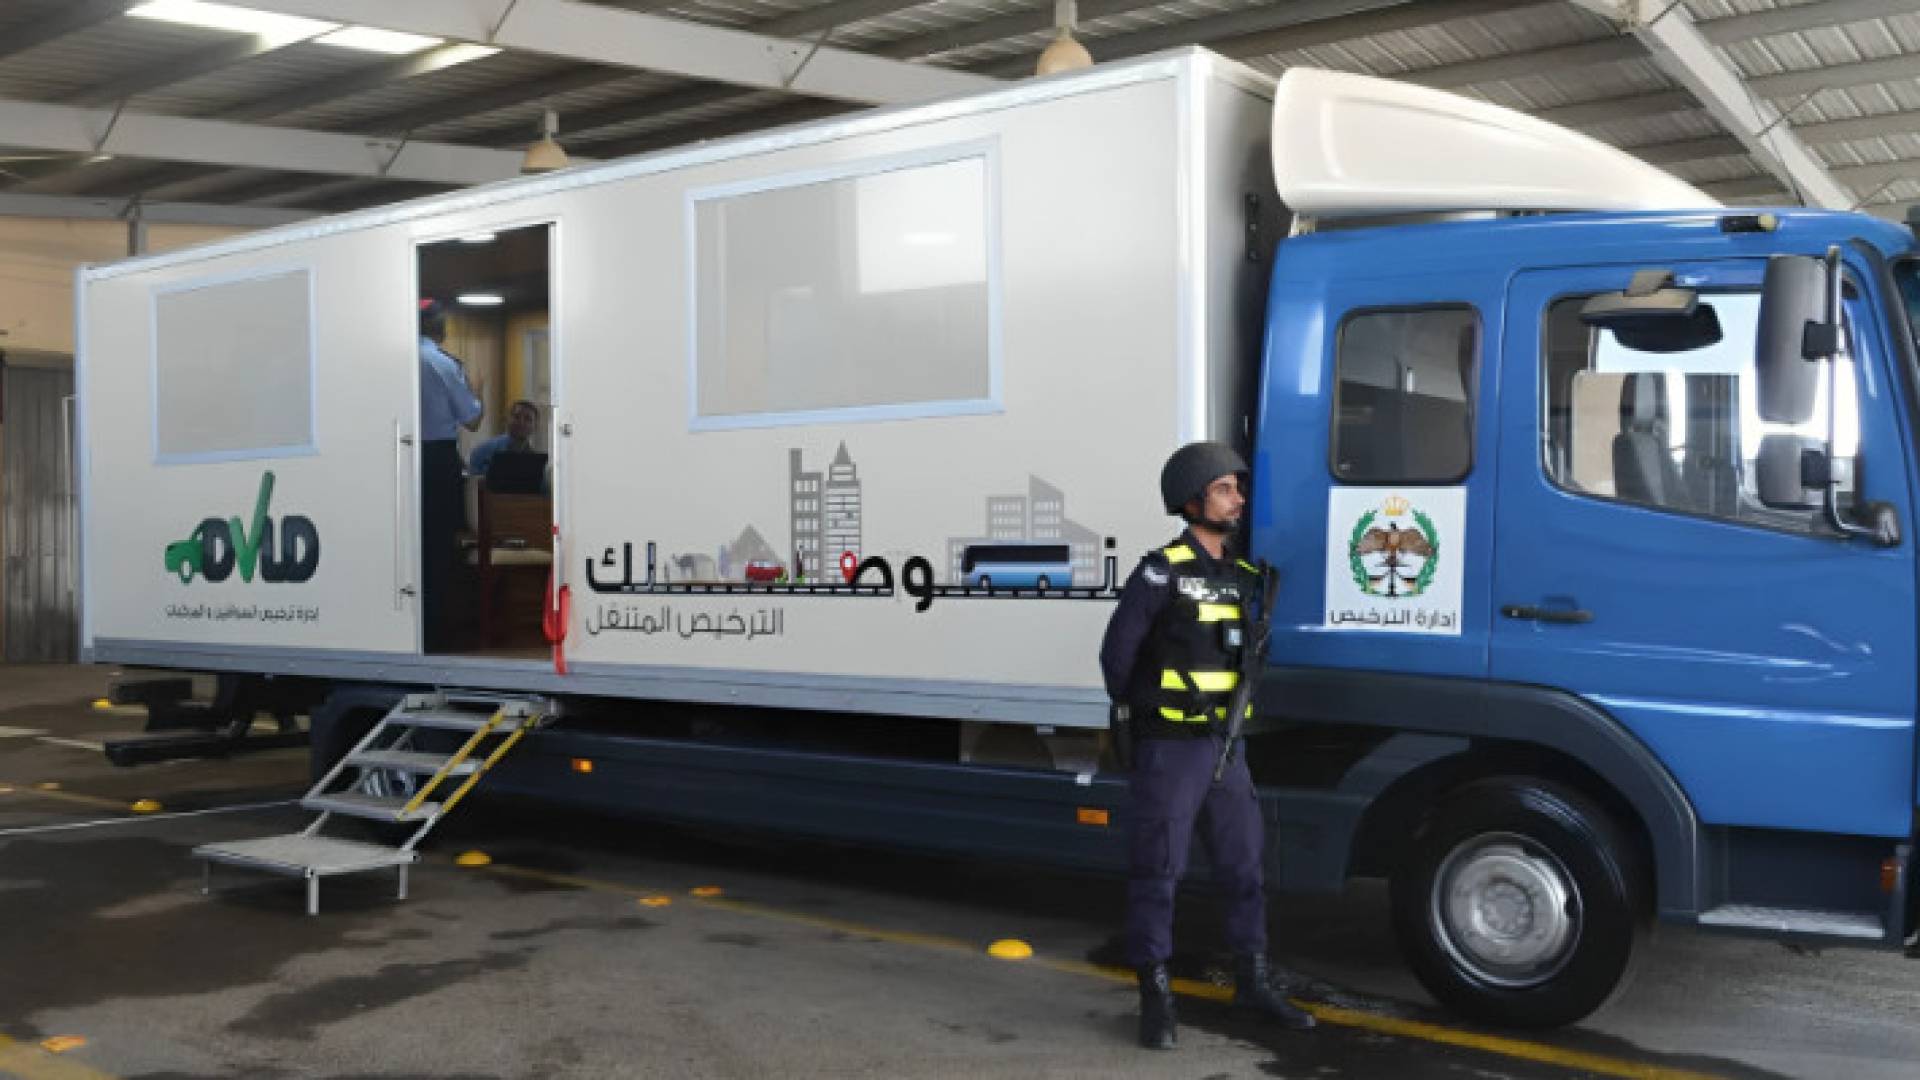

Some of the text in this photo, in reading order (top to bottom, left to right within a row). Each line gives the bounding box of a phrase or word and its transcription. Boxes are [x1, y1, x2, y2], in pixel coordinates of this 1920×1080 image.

[585, 602, 784, 640] الترخيص المتنقل
[1330, 608, 1411, 627] الترخيص
